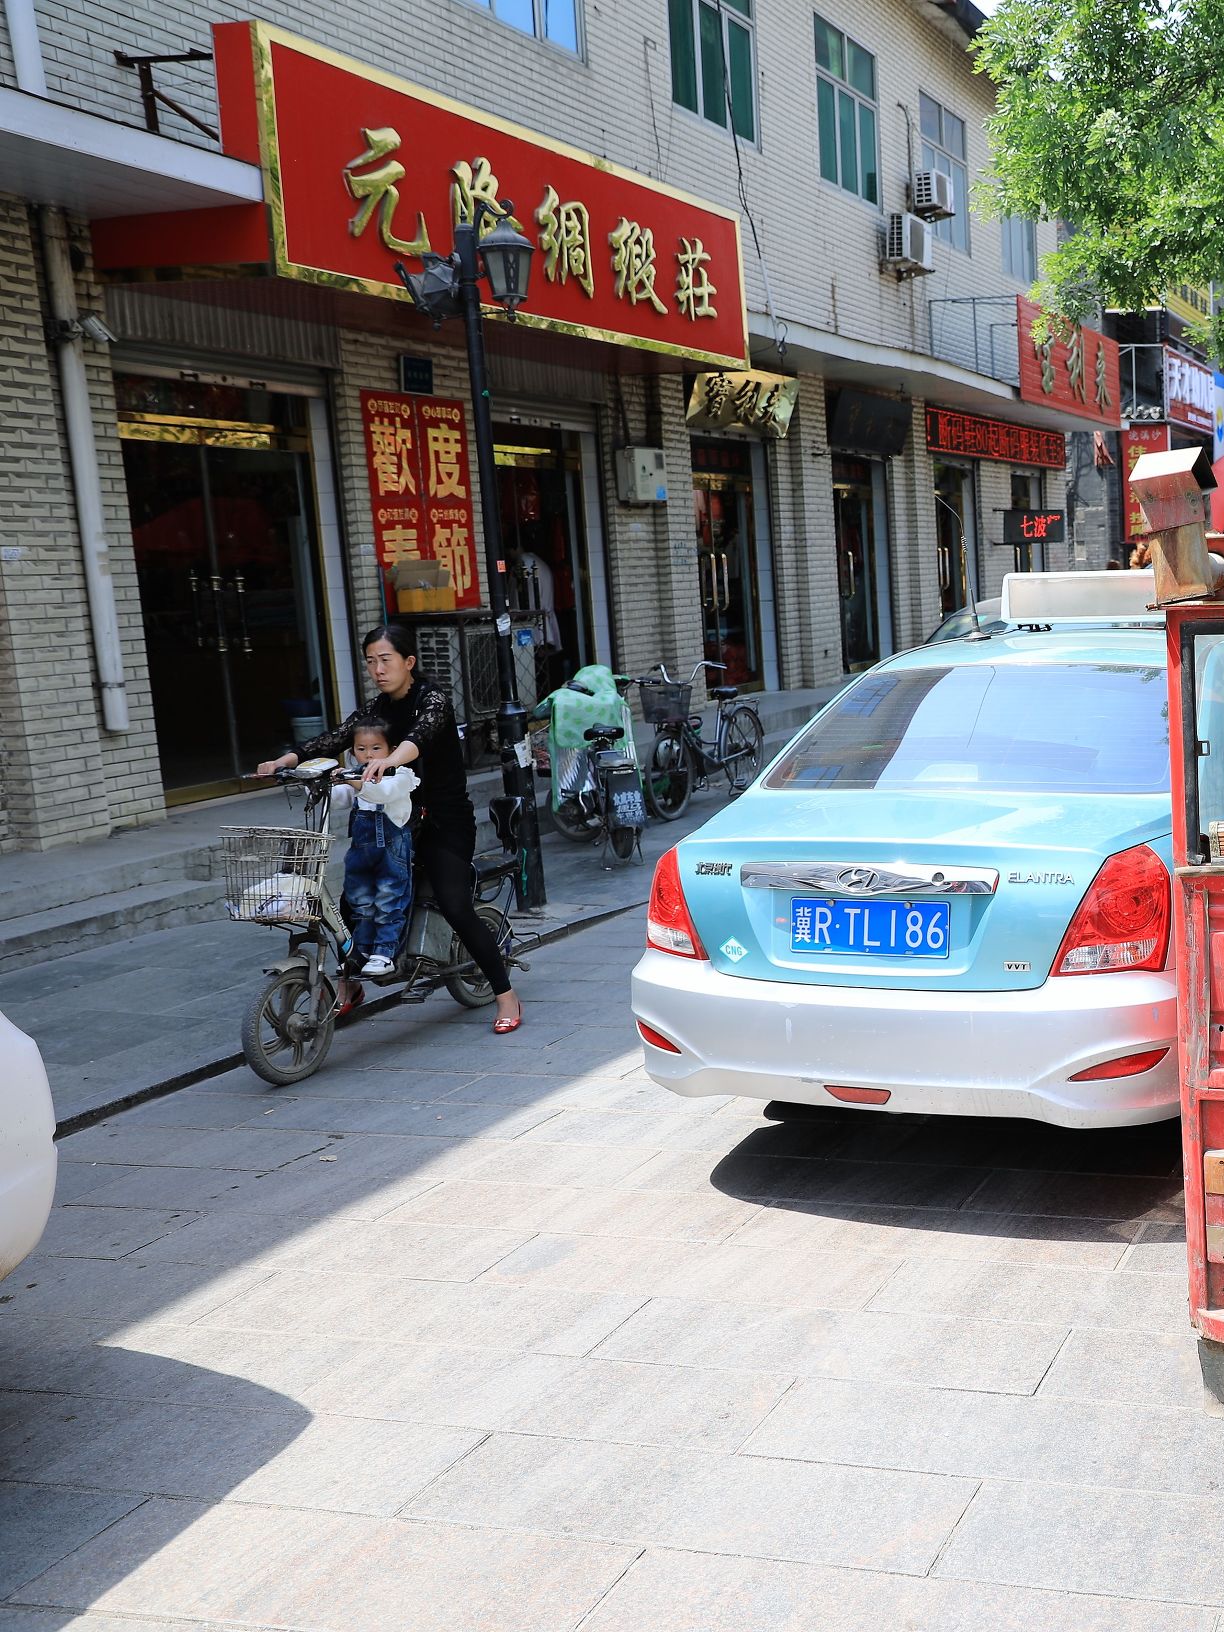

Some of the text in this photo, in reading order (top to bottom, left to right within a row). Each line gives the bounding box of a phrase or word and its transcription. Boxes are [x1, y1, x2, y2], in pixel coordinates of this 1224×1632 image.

[695, 861, 733, 876] 北京现代
[1008, 872, 1075, 885] ELANTRA
[725, 945, 743, 956] CNG
